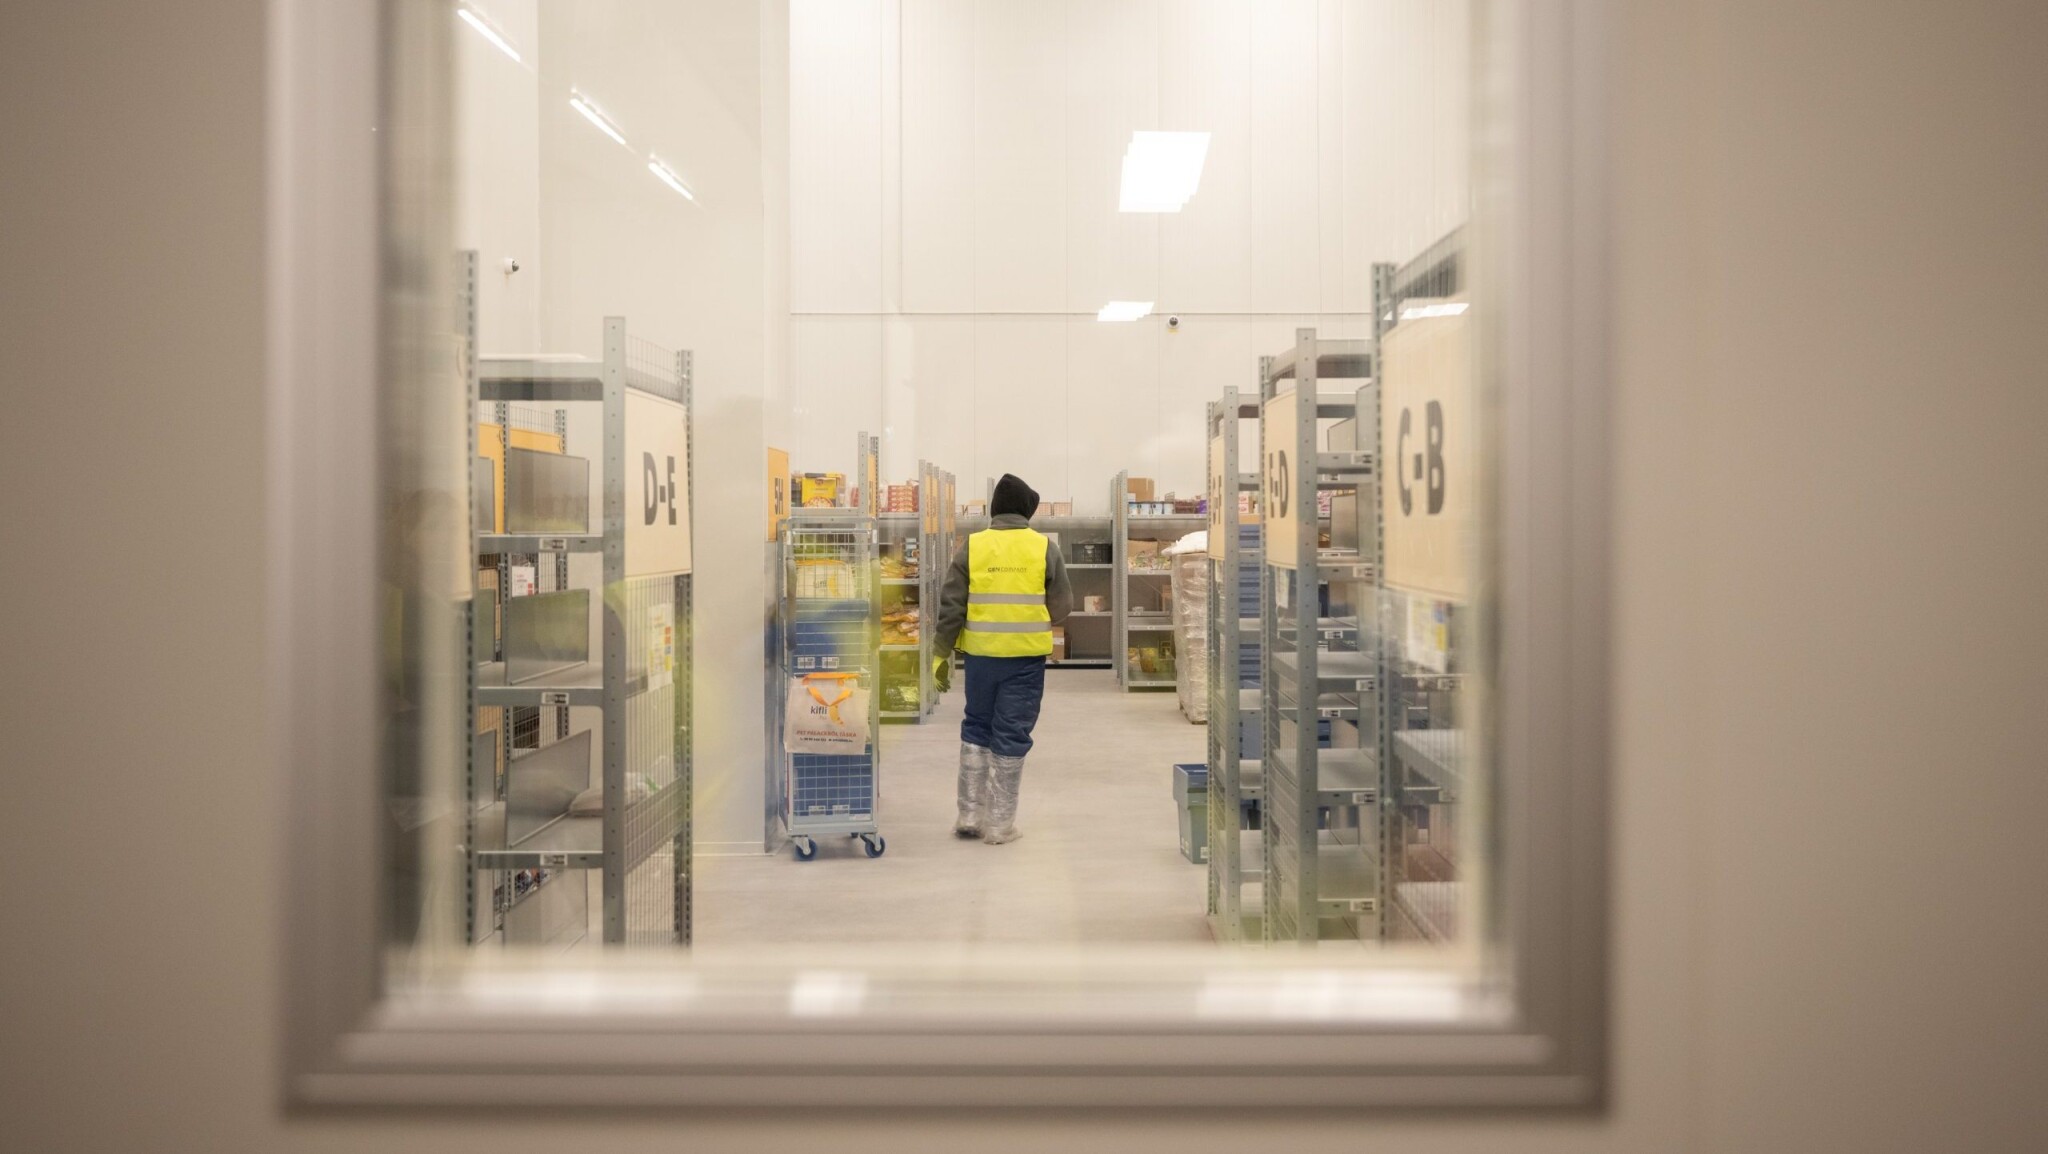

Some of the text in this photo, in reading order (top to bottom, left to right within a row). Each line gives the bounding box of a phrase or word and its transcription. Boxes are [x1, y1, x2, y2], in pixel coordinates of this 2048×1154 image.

[643, 451, 677, 526] D-E
[1268, 449, 1289, 519] E-D
[1398, 400, 1446, 517] C-B
[810, 706, 828, 715] kifli
